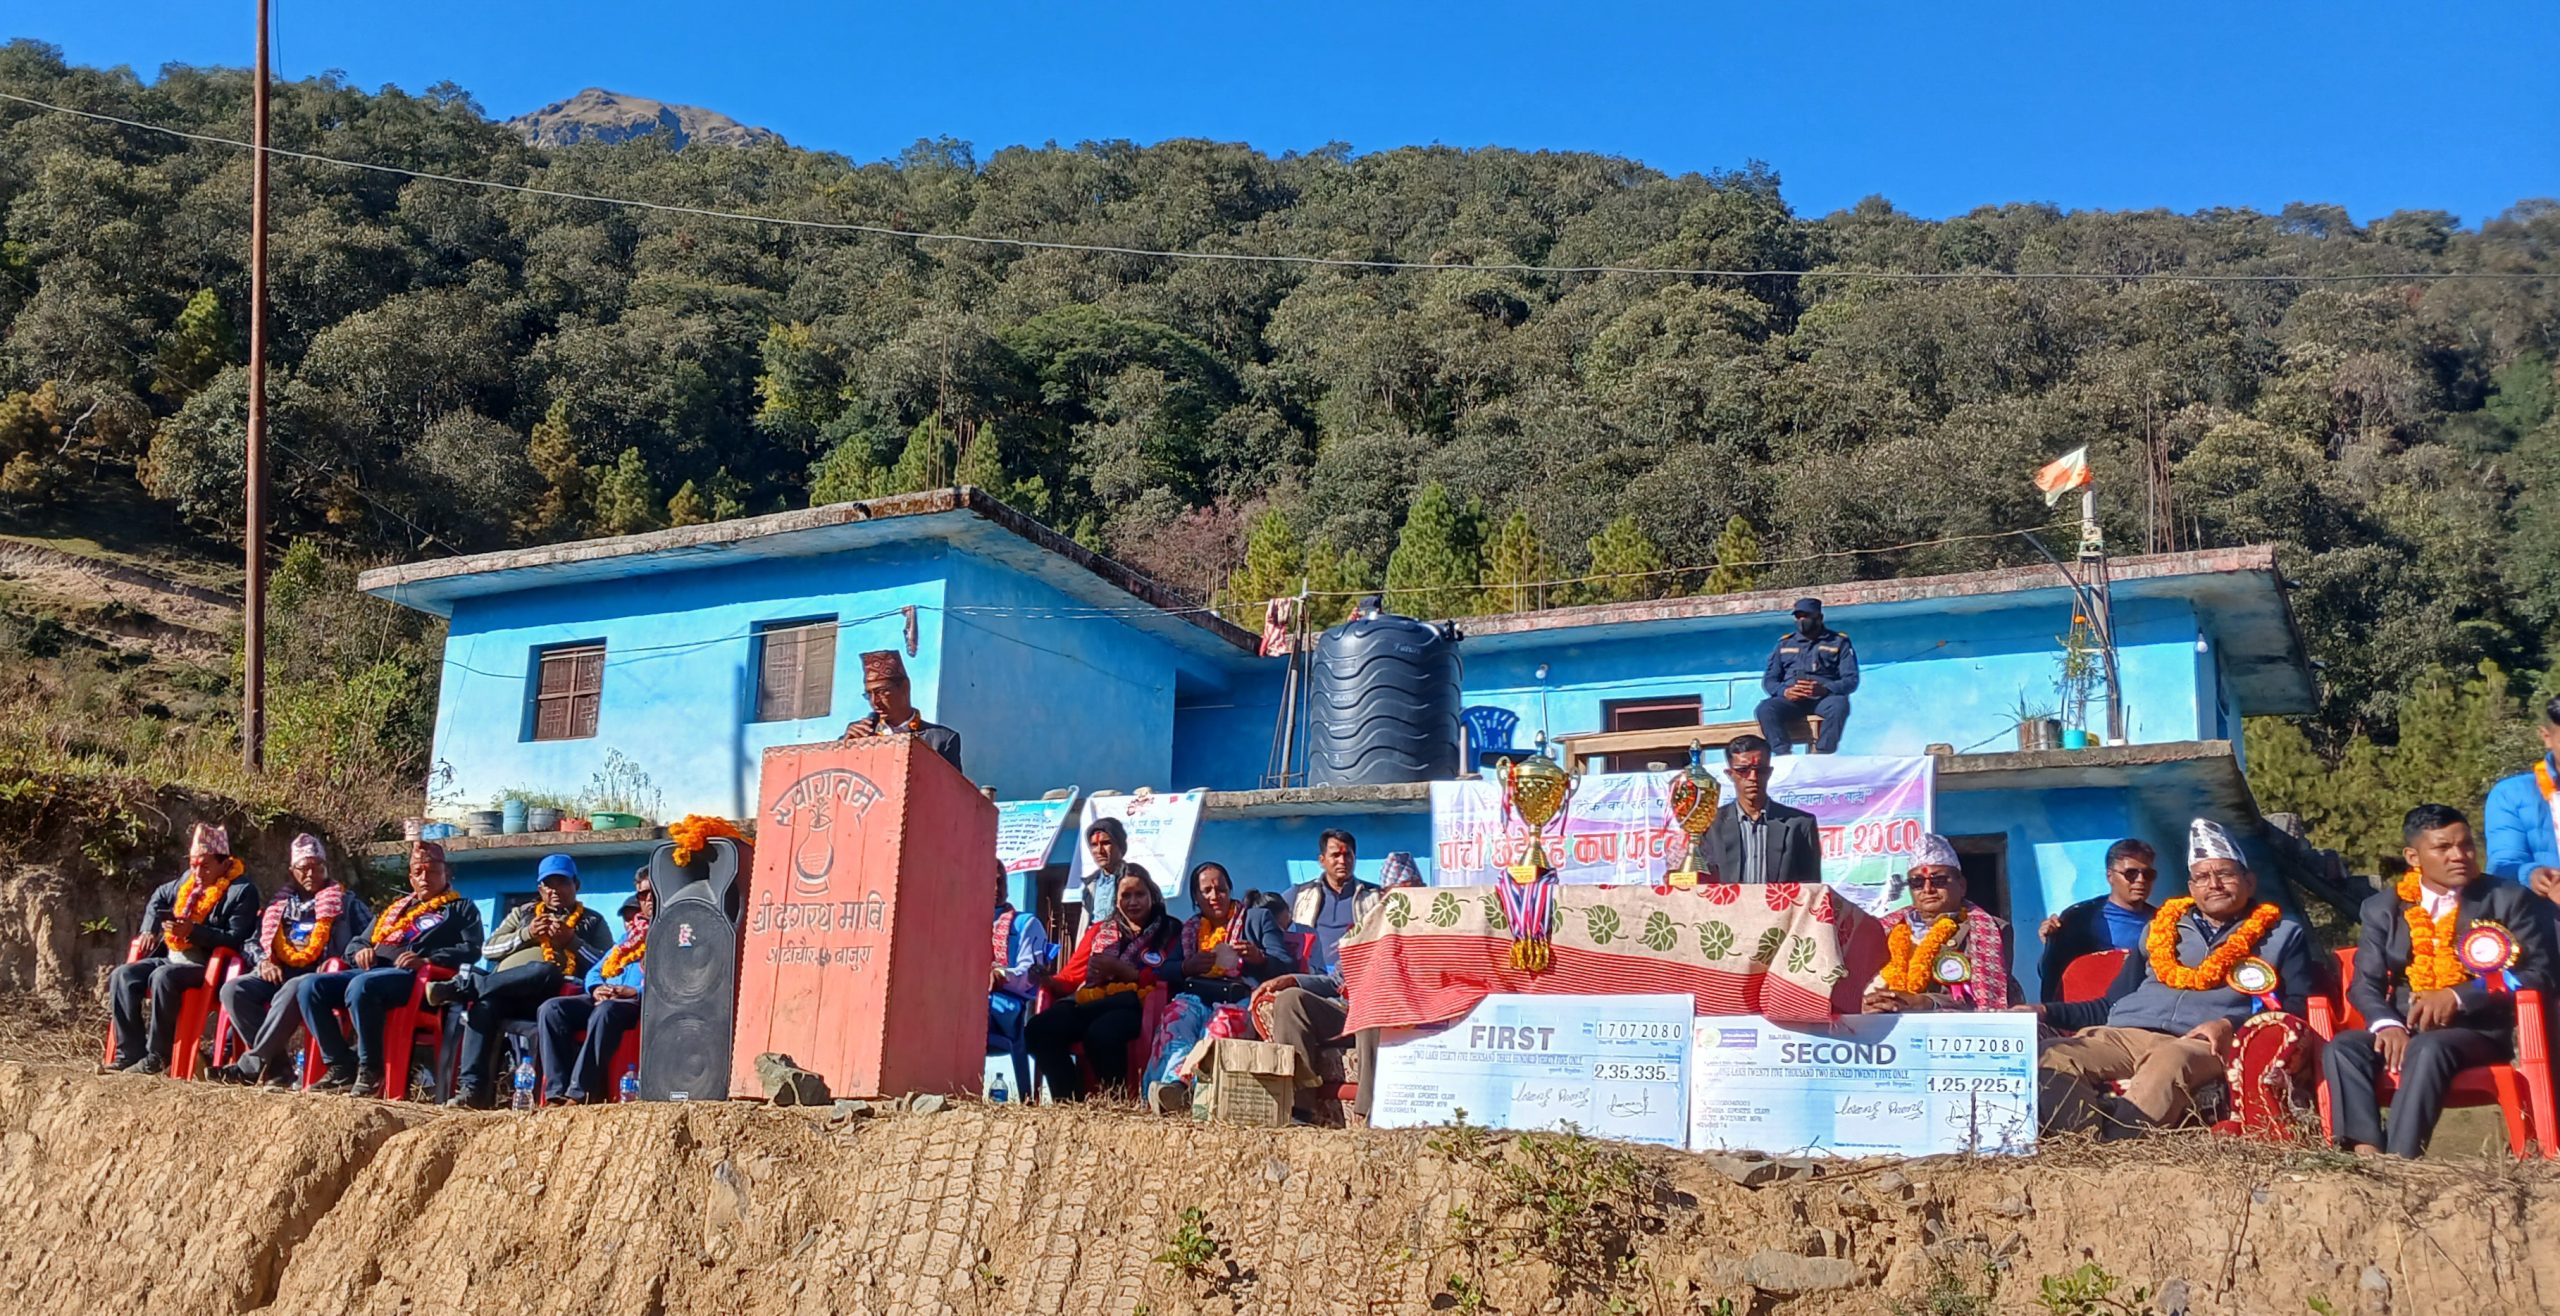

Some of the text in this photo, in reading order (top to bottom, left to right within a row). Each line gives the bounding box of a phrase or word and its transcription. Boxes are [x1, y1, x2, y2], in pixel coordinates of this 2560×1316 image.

[770, 768, 885, 830] स्वागतम्
[1573, 832, 1619, 865] कप
[1853, 818, 1922, 855] २०८०
[752, 889, 775, 934] श्री
[834, 945, 874, 972] बाजुरा
[1470, 1026, 1555, 1051] FIRST
[1780, 1042, 1897, 1066] SECOND
